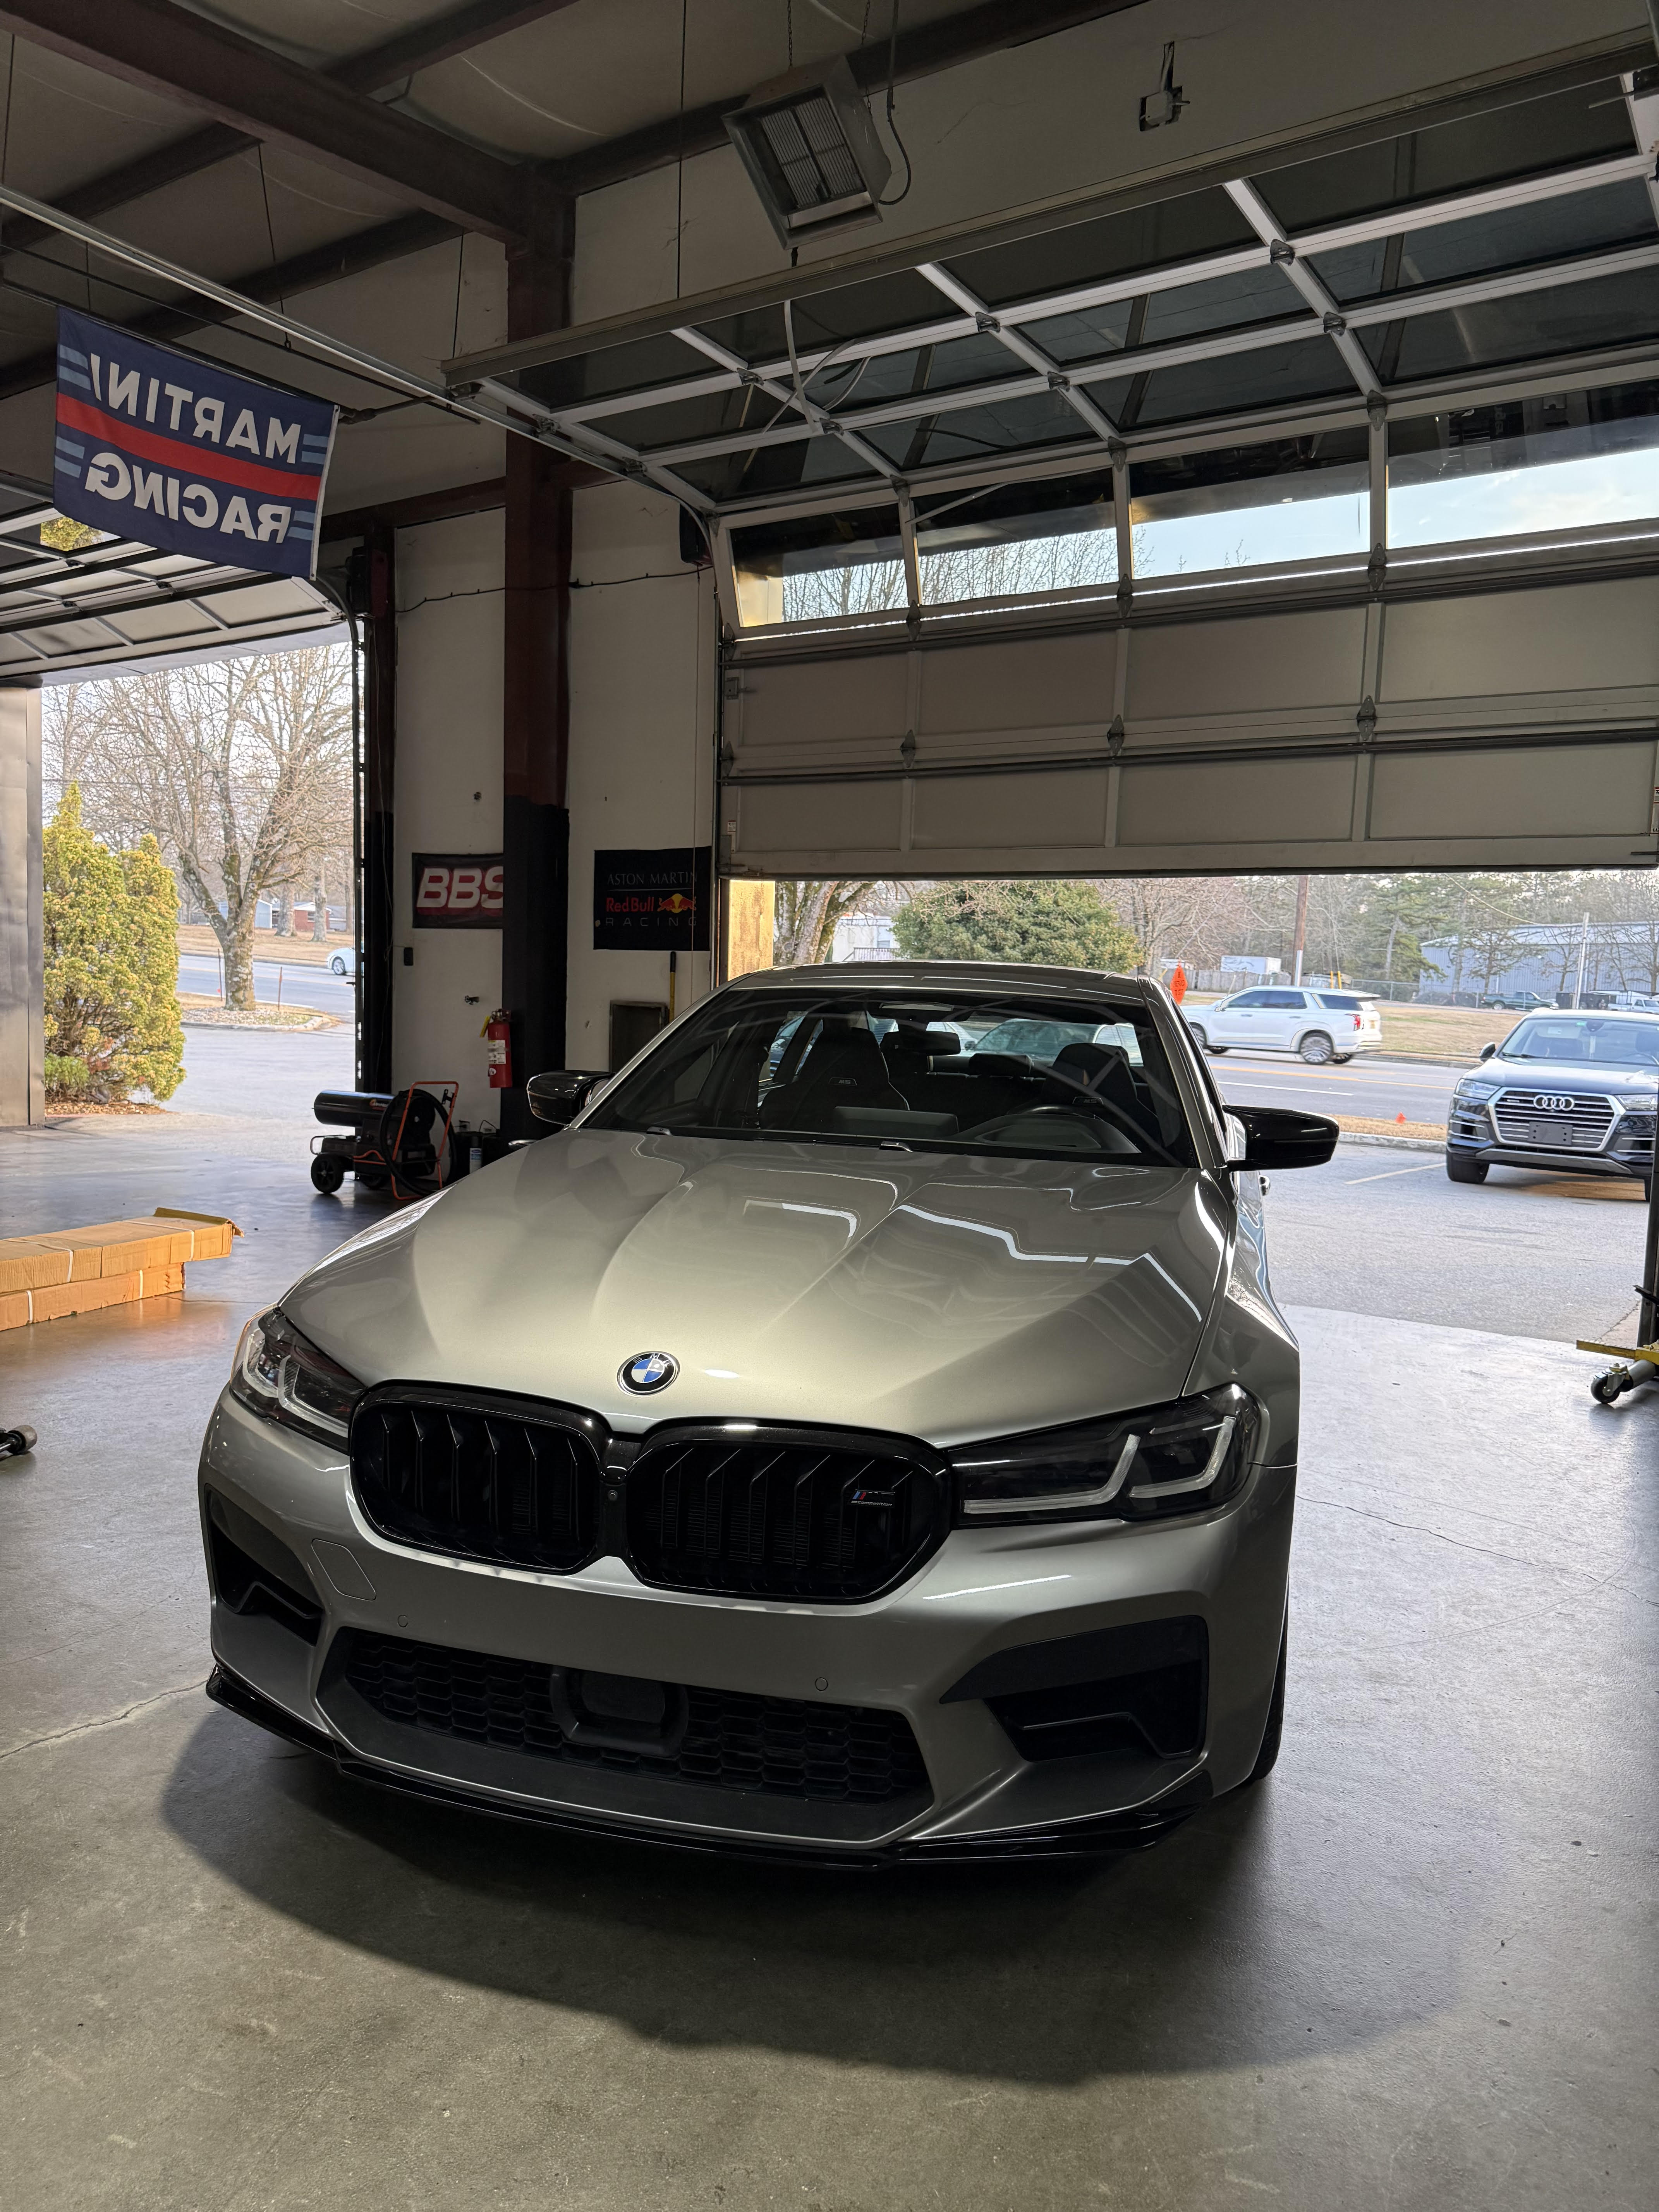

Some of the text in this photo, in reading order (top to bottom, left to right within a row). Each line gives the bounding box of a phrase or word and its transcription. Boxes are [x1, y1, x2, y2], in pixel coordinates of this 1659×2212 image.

[607, 871, 697, 885] ASTON MARTIN
[416, 866, 503, 909] BBS
[605, 916, 696, 927] RACING
